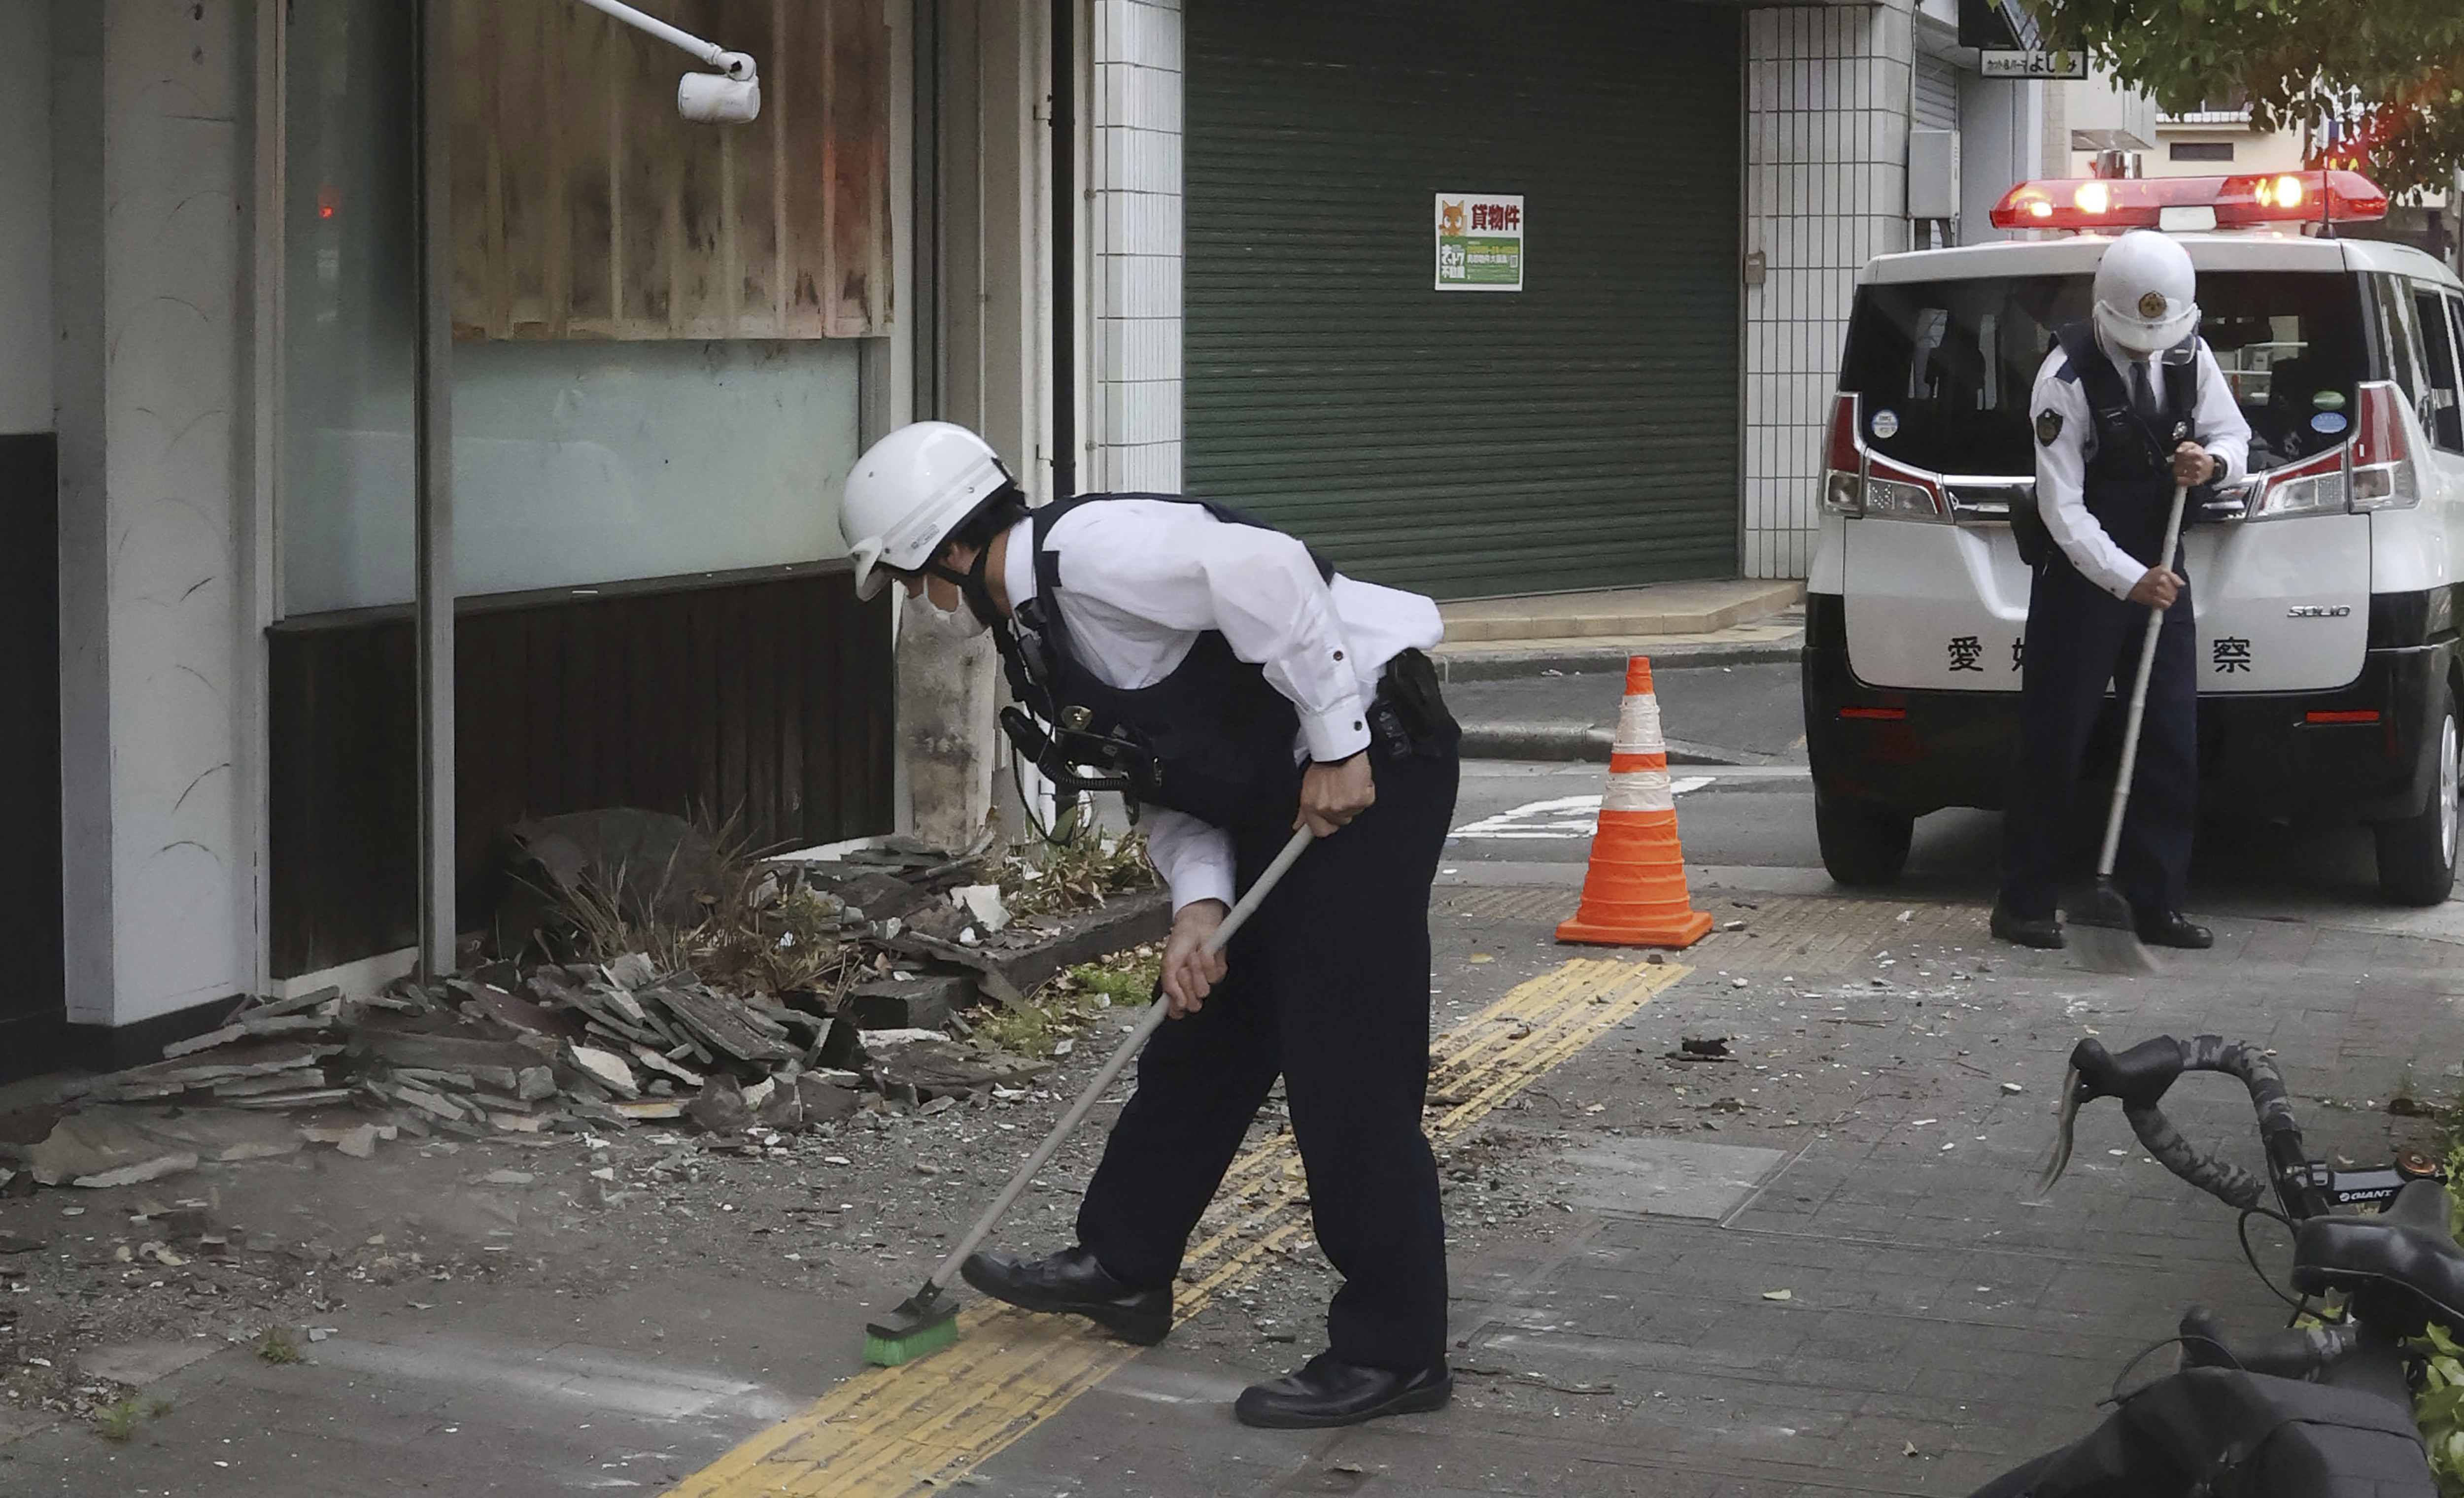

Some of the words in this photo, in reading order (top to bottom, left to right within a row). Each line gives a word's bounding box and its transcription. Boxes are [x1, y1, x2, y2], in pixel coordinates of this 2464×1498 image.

[1472, 204, 1520, 231] 貸物件
[2287, 605, 2351, 618] SOLIO
[2351, 1190, 2393, 1199] GIANT
